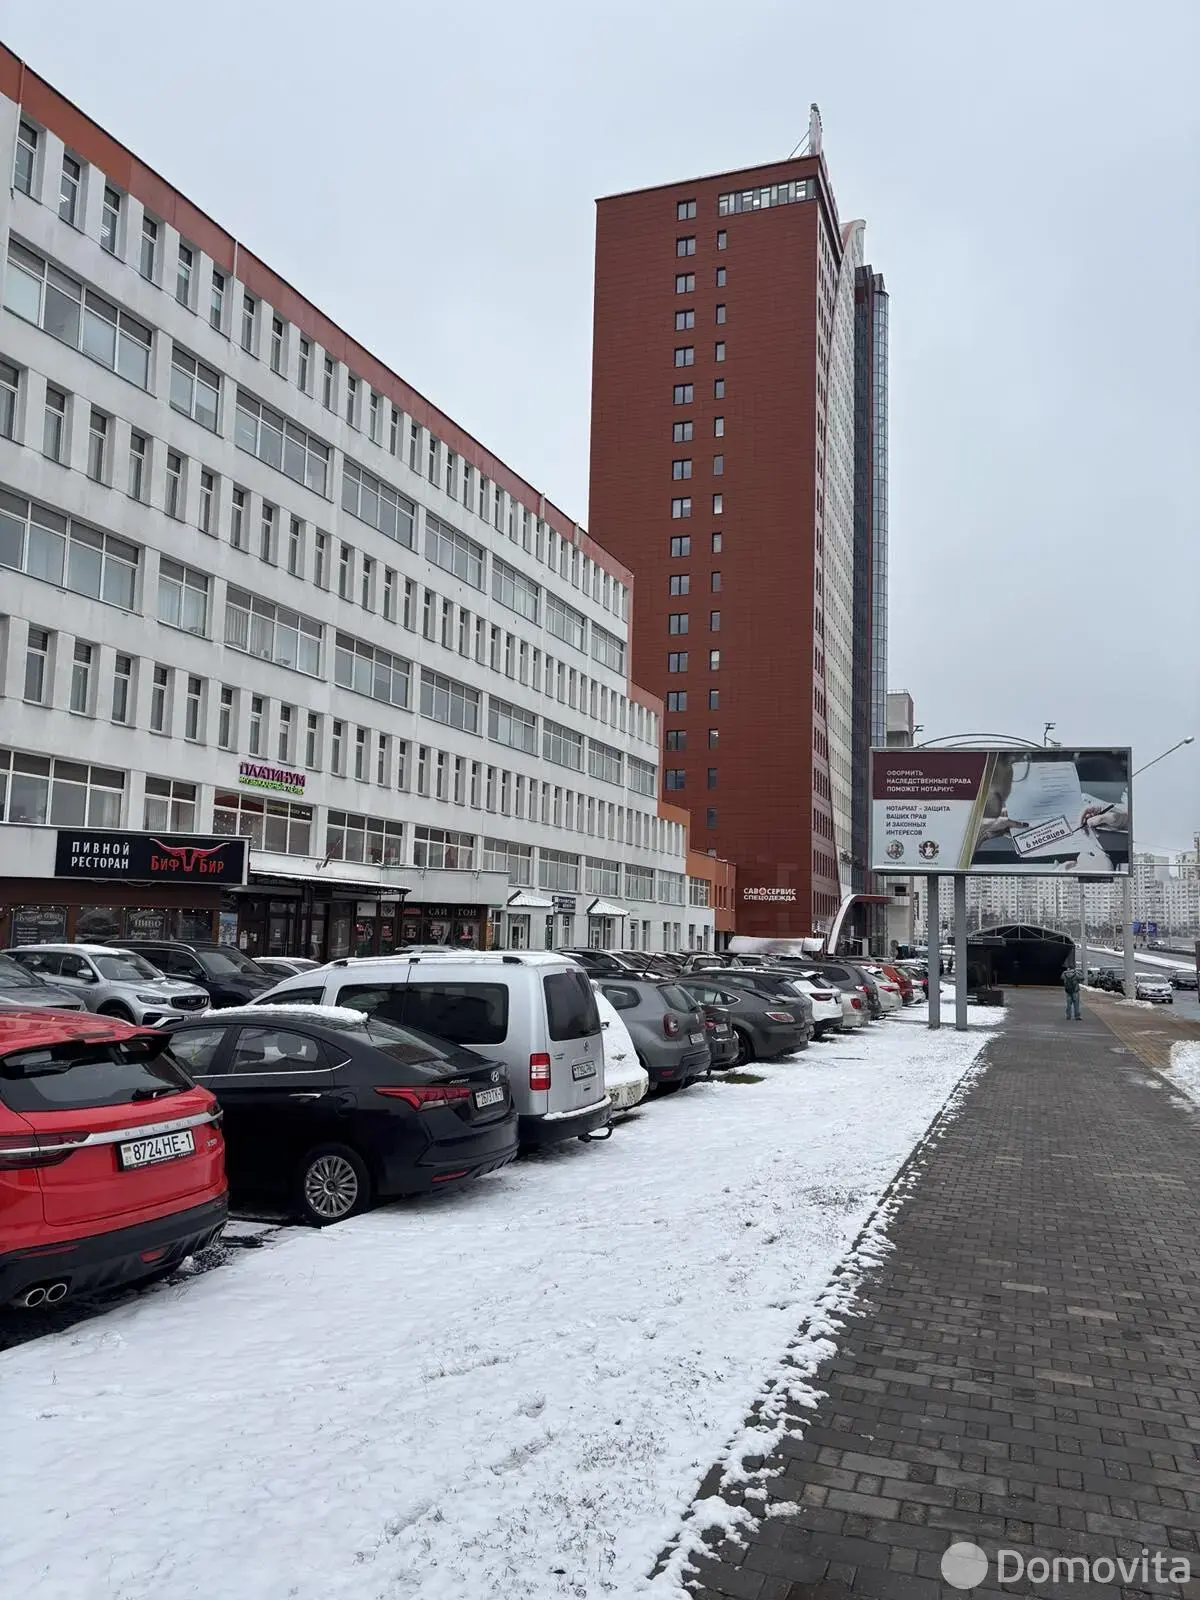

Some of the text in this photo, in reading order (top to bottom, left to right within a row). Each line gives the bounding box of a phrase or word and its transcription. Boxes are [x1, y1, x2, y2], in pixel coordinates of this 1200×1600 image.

[239, 762, 305, 787] ПЛАТИНУМ
[1032, 829, 1065, 846] месяцев
[72, 841, 130, 855] ПИВНОЙ
[71, 856, 129, 870] РЕСТОРАН
[151, 855, 225, 873] БИФ БИР
[743, 887, 796, 895] САВОСЕРВИС
